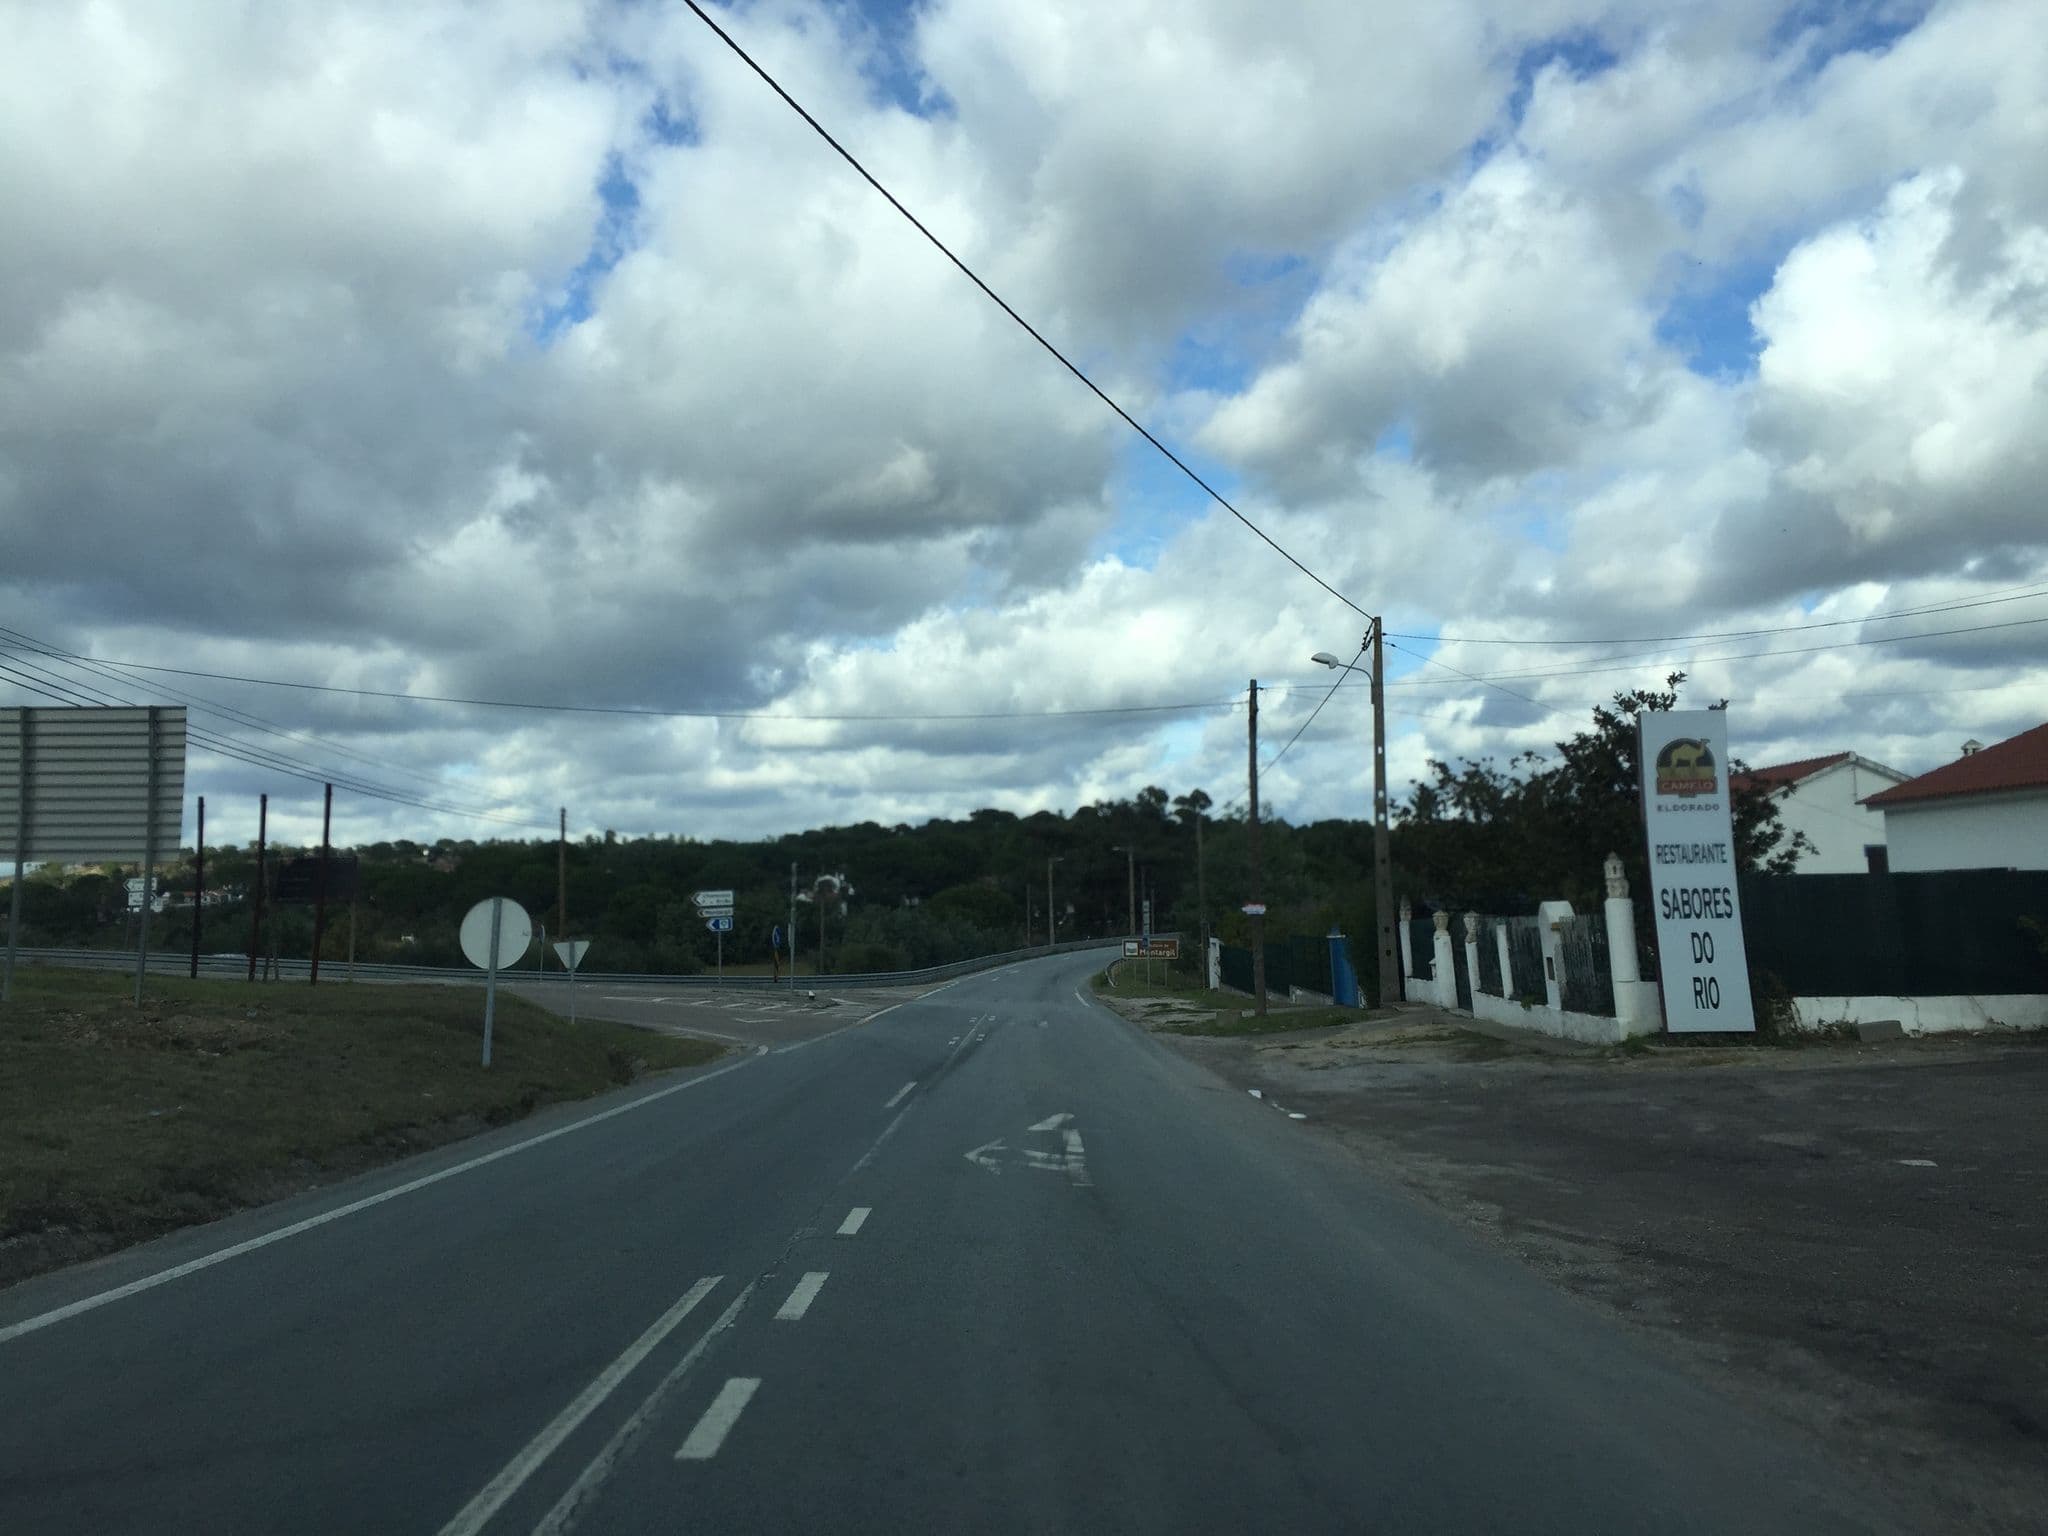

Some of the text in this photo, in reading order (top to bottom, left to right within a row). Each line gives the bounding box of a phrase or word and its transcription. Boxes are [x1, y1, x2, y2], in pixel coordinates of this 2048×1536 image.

[1656, 803, 1720, 812] ELDORADO
[1655, 843, 1728, 864] RESTAURANTE
[1660, 886, 1733, 919] SABORES
[1690, 931, 1715, 964] DO
[1692, 976, 1720, 1010] RIO
